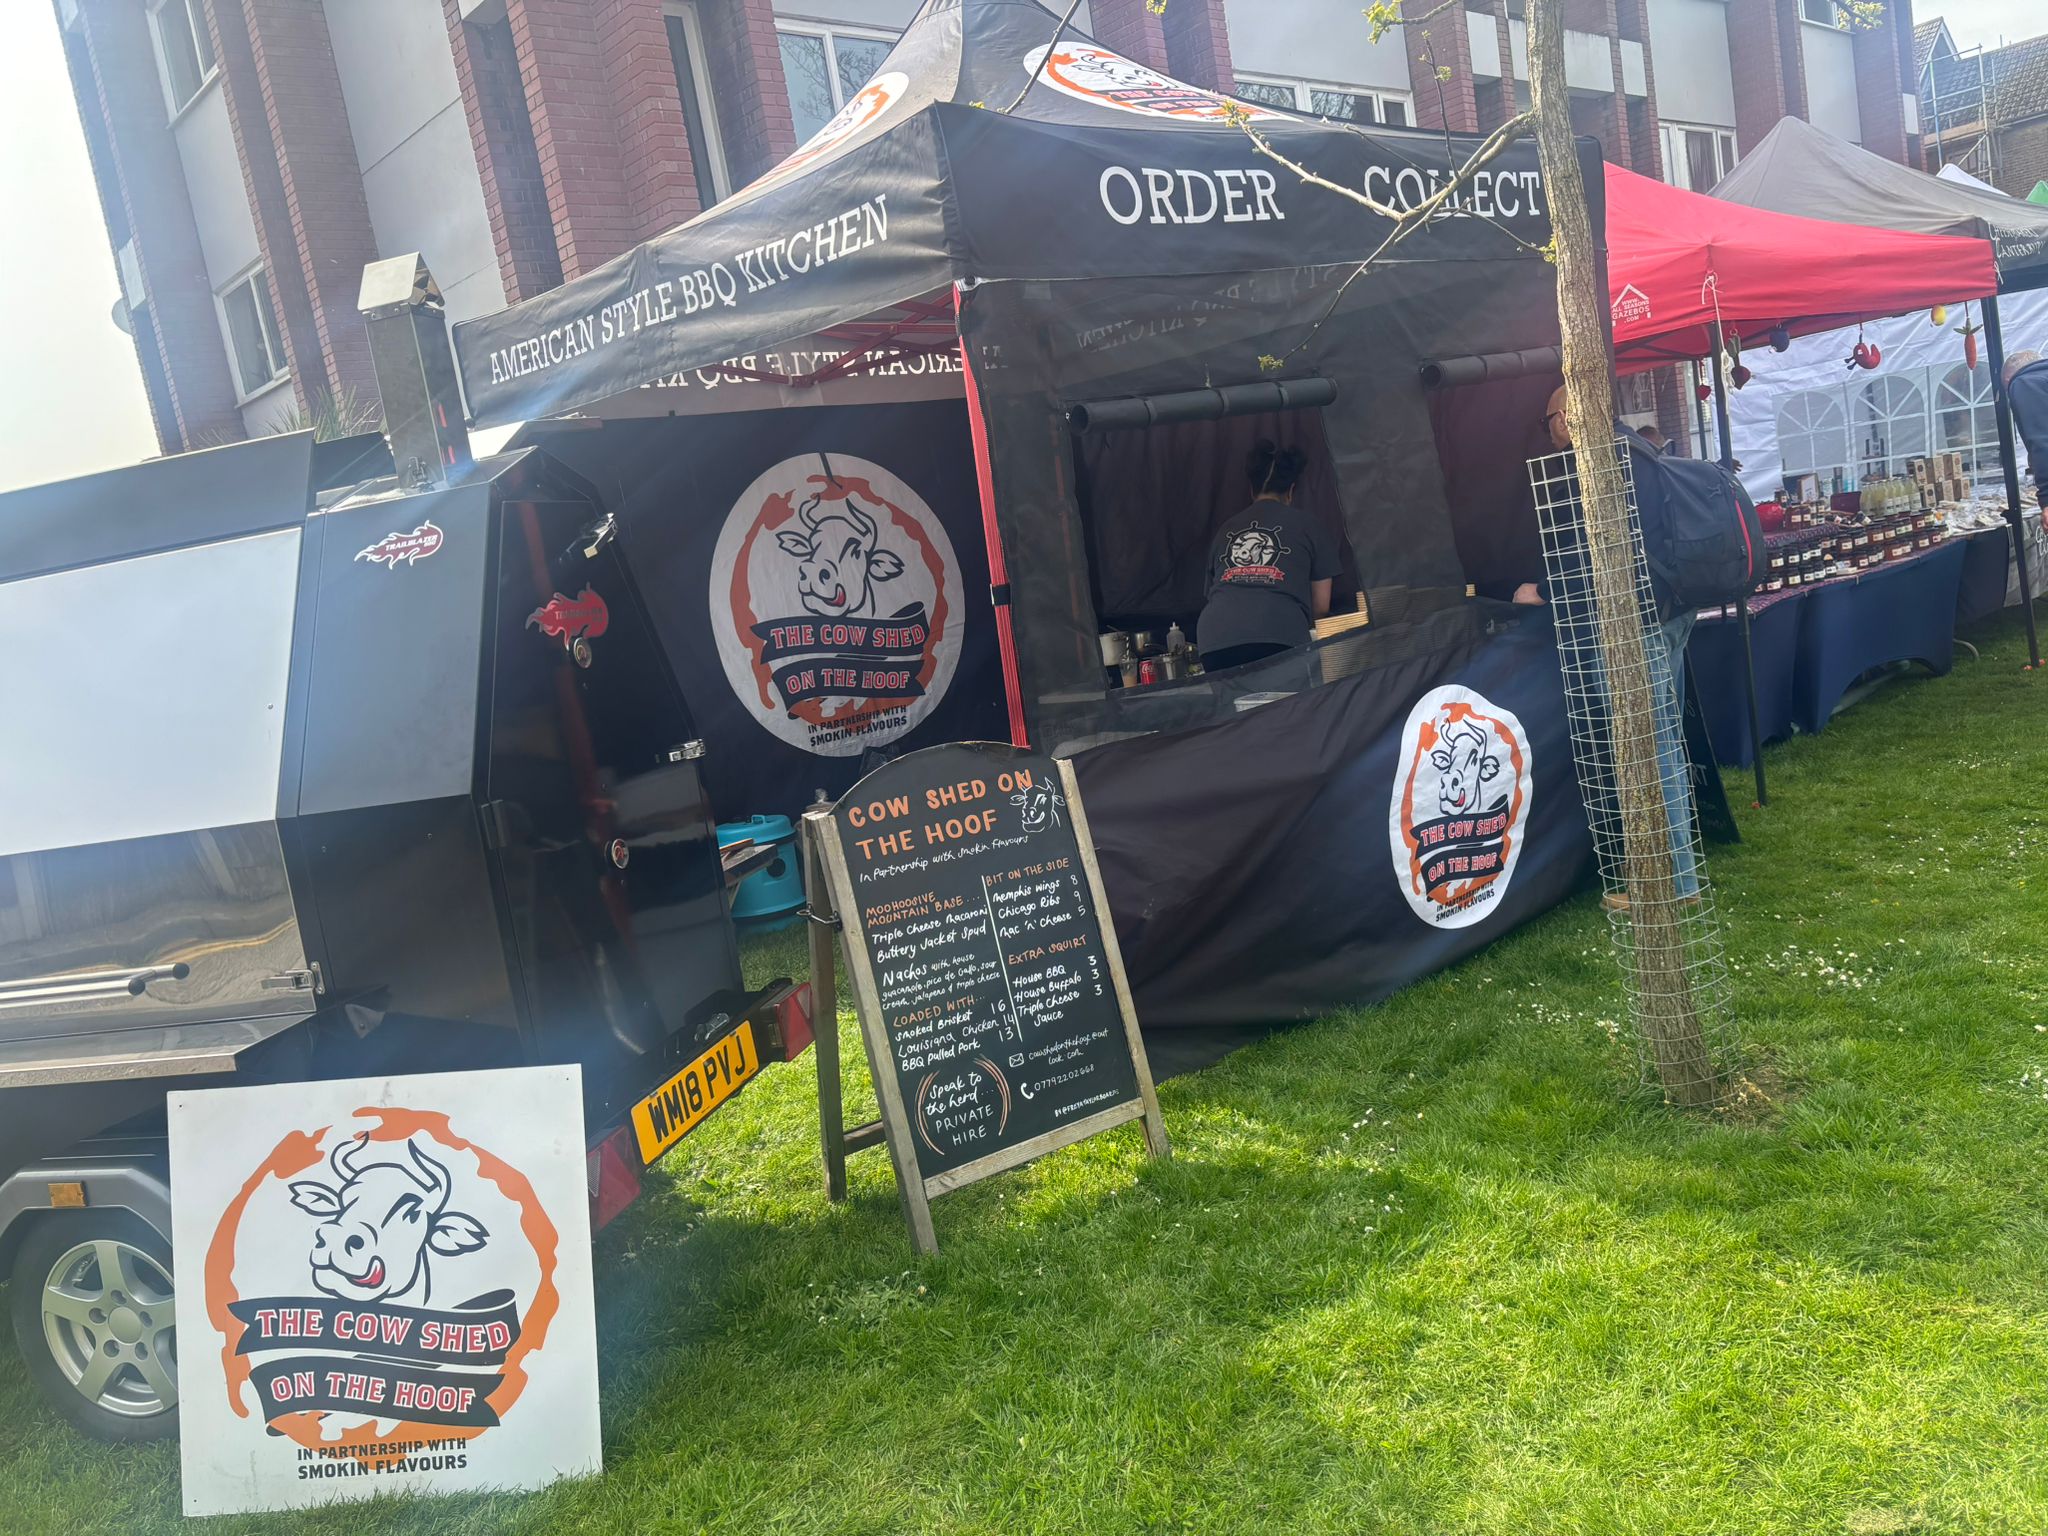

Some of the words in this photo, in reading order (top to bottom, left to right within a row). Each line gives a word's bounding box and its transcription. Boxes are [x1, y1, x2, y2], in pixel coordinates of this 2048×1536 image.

[1100, 166, 1285, 225] ORDER
[1364, 165, 1541, 218] COLLECT
[490, 315, 595, 384] AMERICAN
[601, 281, 677, 344] STYLE
[679, 262, 737, 314] BBQ
[735, 193, 888, 293] KITCHEN
[1612, 305, 1650, 319] GAZEBOS
[385, 534, 438, 551] TRAILBLAZER
[770, 625, 815, 649] THE
[820, 624, 867, 646] COW
[872, 623, 925, 648] SHED
[786, 670, 815, 694] ON
[821, 669, 856, 687] THE
[862, 671, 910, 689] HOOF
[808, 724, 818, 734] IN
[820, 710, 880, 730] PARTNERSHIP
[883, 705, 907, 716] WITH
[810, 728, 852, 747] SMOKIN
[856, 716, 907, 736] FLAVOURS
[848, 795, 910, 828] COW
[926, 779, 986, 810] SHED
[997, 769, 1033, 791] ON
[855, 829, 915, 860] THE
[925, 809, 997, 845] HOOF
[1420, 824, 1445, 846] THE
[1447, 820, 1474, 839] COW
[1476, 813, 1506, 836] SHED
[932, 851, 956, 863] with
[985, 872, 1003, 886] BIT
[1008, 870, 1021, 880] ON
[1023, 863, 1044, 876] THE
[1046, 857, 1070, 871] SIDE
[1428, 861, 1445, 881] ON
[1448, 857, 1469, 873] THE
[1471, 852, 1498, 871] HOOF
[993, 885, 1031, 903] Memphis
[1070, 874, 1078, 885] 8
[1445, 887, 1480, 908] PARTNERSHIP
[1481, 880, 1494, 892] WITH
[866, 891, 936, 919] MOOHOOSIVE
[868, 905, 929, 929] MOUNTAIN
[998, 902, 1036, 919] Chicago
[1040, 895, 1061, 908] Ribs
[1074, 890, 1081, 902] 9
[1436, 905, 1462, 922] SMOKIN
[1464, 888, 1495, 910] FLAVOURS
[872, 928, 903, 945] Triple
[906, 920, 941, 935] Cheese
[945, 904, 988, 924] Macaroni
[999, 925, 1020, 938] Mac
[1078, 905, 1086, 917] 5
[877, 943, 916, 963] Buttery
[920, 929, 957, 950] Jacket
[961, 919, 986, 941] Spud
[1008, 946, 1045, 965] EXTRA
[1049, 934, 1087, 954] SQUIRT
[882, 962, 927, 987] Nachos
[931, 959, 951, 971] with
[952, 953, 975, 964] house
[926, 976, 942, 989] pico
[944, 971, 956, 981] de
[981, 960, 997, 970] sour
[977, 972, 1001, 984] cheese
[1012, 973, 1043, 988] House
[1046, 965, 1066, 979] BBQ
[1088, 955, 1097, 966] 3
[1014, 987, 1046, 1003] House
[1048, 970, 1082, 992] Buffalo
[1091, 969, 1100, 980] 3
[937, 1009, 973, 1029] Brisket
[991, 999, 1006, 1015] 16
[1016, 1000, 1044, 1018] Triple
[1046, 990, 1080, 1008] Cheese
[1094, 984, 1102, 996] 3
[893, 1005, 941, 1027] LOADED
[898, 1032, 956, 1057] Louisiana
[962, 1019, 999, 1036] Chicken
[1003, 1013, 1015, 1026] 14
[902, 1056, 925, 1071] BBQ
[958, 1038, 981, 1054] Pork
[998, 1026, 1014, 1042] 13
[648, 1070, 703, 1144] WM18
[703, 1034, 746, 1100] PVJ
[930, 1075, 965, 1099] Speak
[968, 1071, 982, 1086] to
[1034, 1063, 1094, 1090] 07792202668
[925, 1101, 947, 1115] the
[935, 1104, 994, 1134] PRIVATE
[952, 1124, 987, 1146] HIRE
[255, 1308, 323, 1338] THE
[333, 1311, 414, 1345] COW
[419, 1320, 511, 1352] SHED
[271, 1371, 315, 1402] ON
[325, 1372, 386, 1403] THE
[393, 1381, 476, 1413] HOOF
[297, 1449, 313, 1461] IN
[318, 1440, 423, 1459] PARTNERSHIP
[428, 1438, 467, 1452] WITH
[298, 1460, 370, 1480] SMOKIN
[376, 1454, 468, 1475] FLAVOURS
